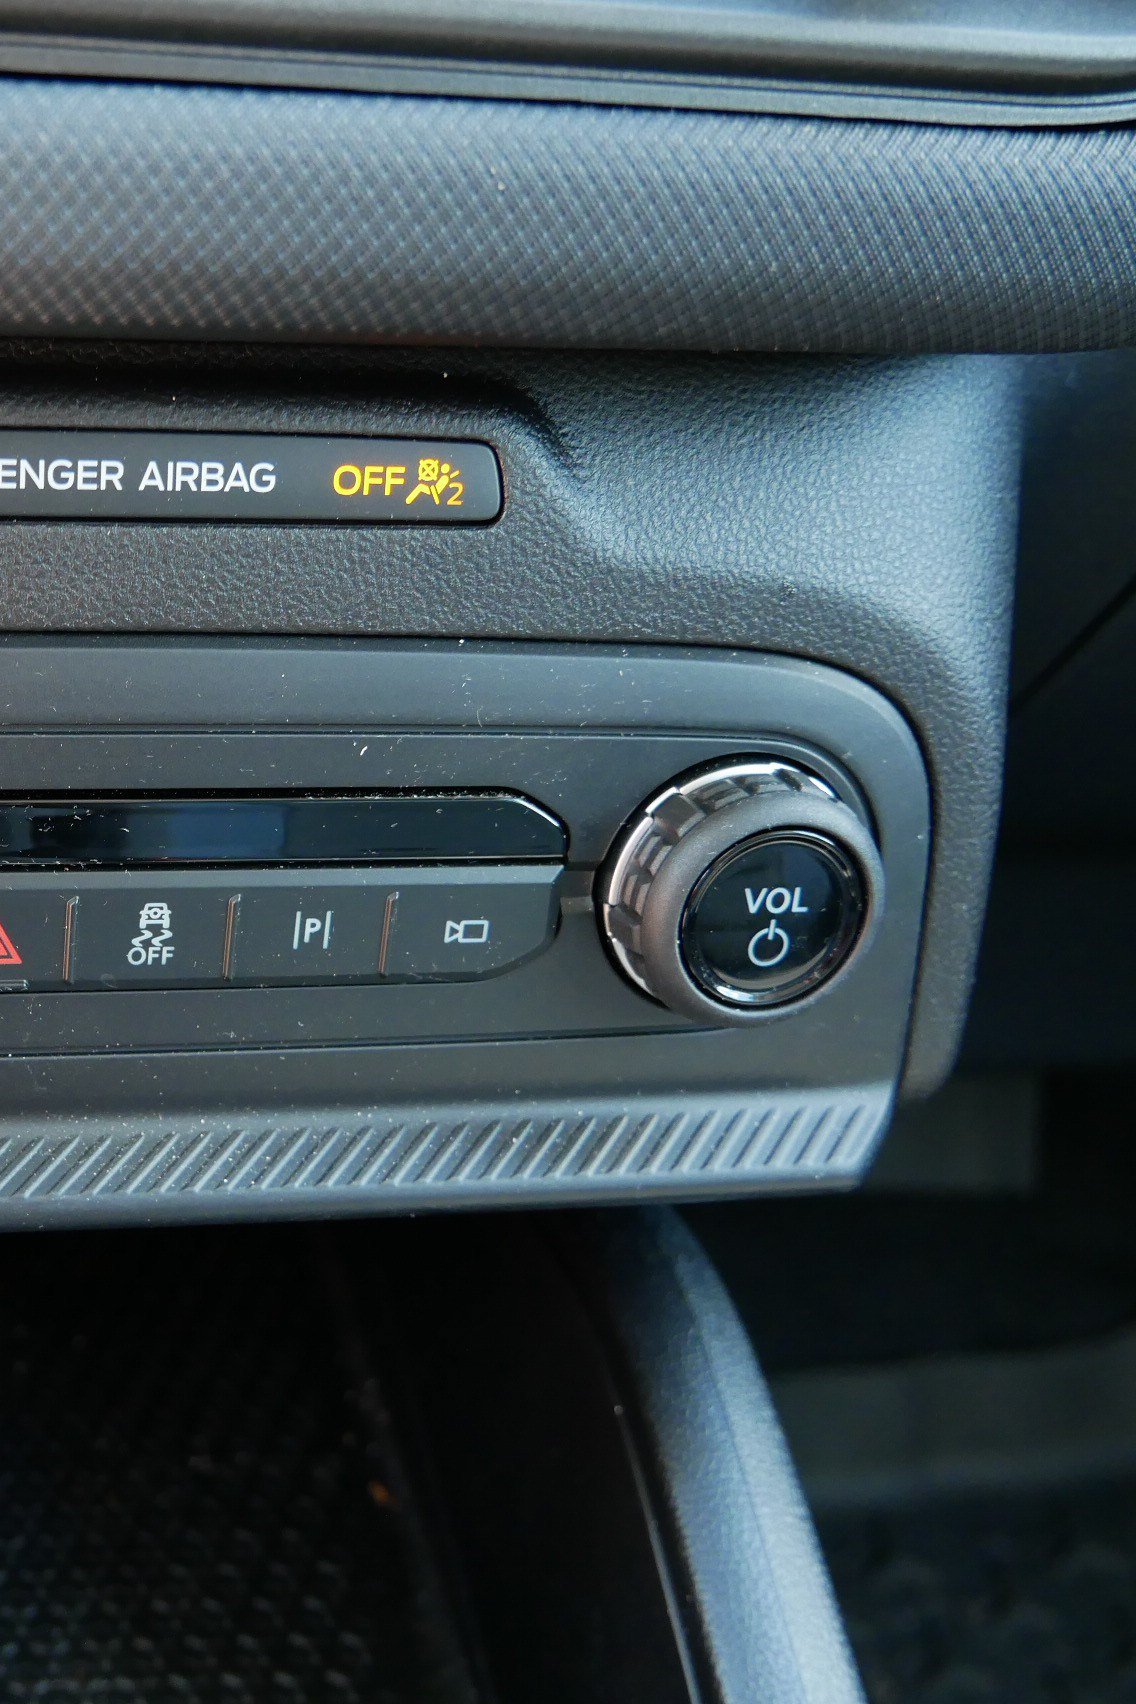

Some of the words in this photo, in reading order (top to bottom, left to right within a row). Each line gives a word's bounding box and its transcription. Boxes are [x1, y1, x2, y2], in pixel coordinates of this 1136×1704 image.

[139, 461, 275, 492] AIRBAG
[333, 465, 405, 494] OFF
[448, 483, 462, 504] 2
[745, 887, 807, 912] VOL
[305, 918, 320, 941] P
[127, 946, 173, 964] OFF
